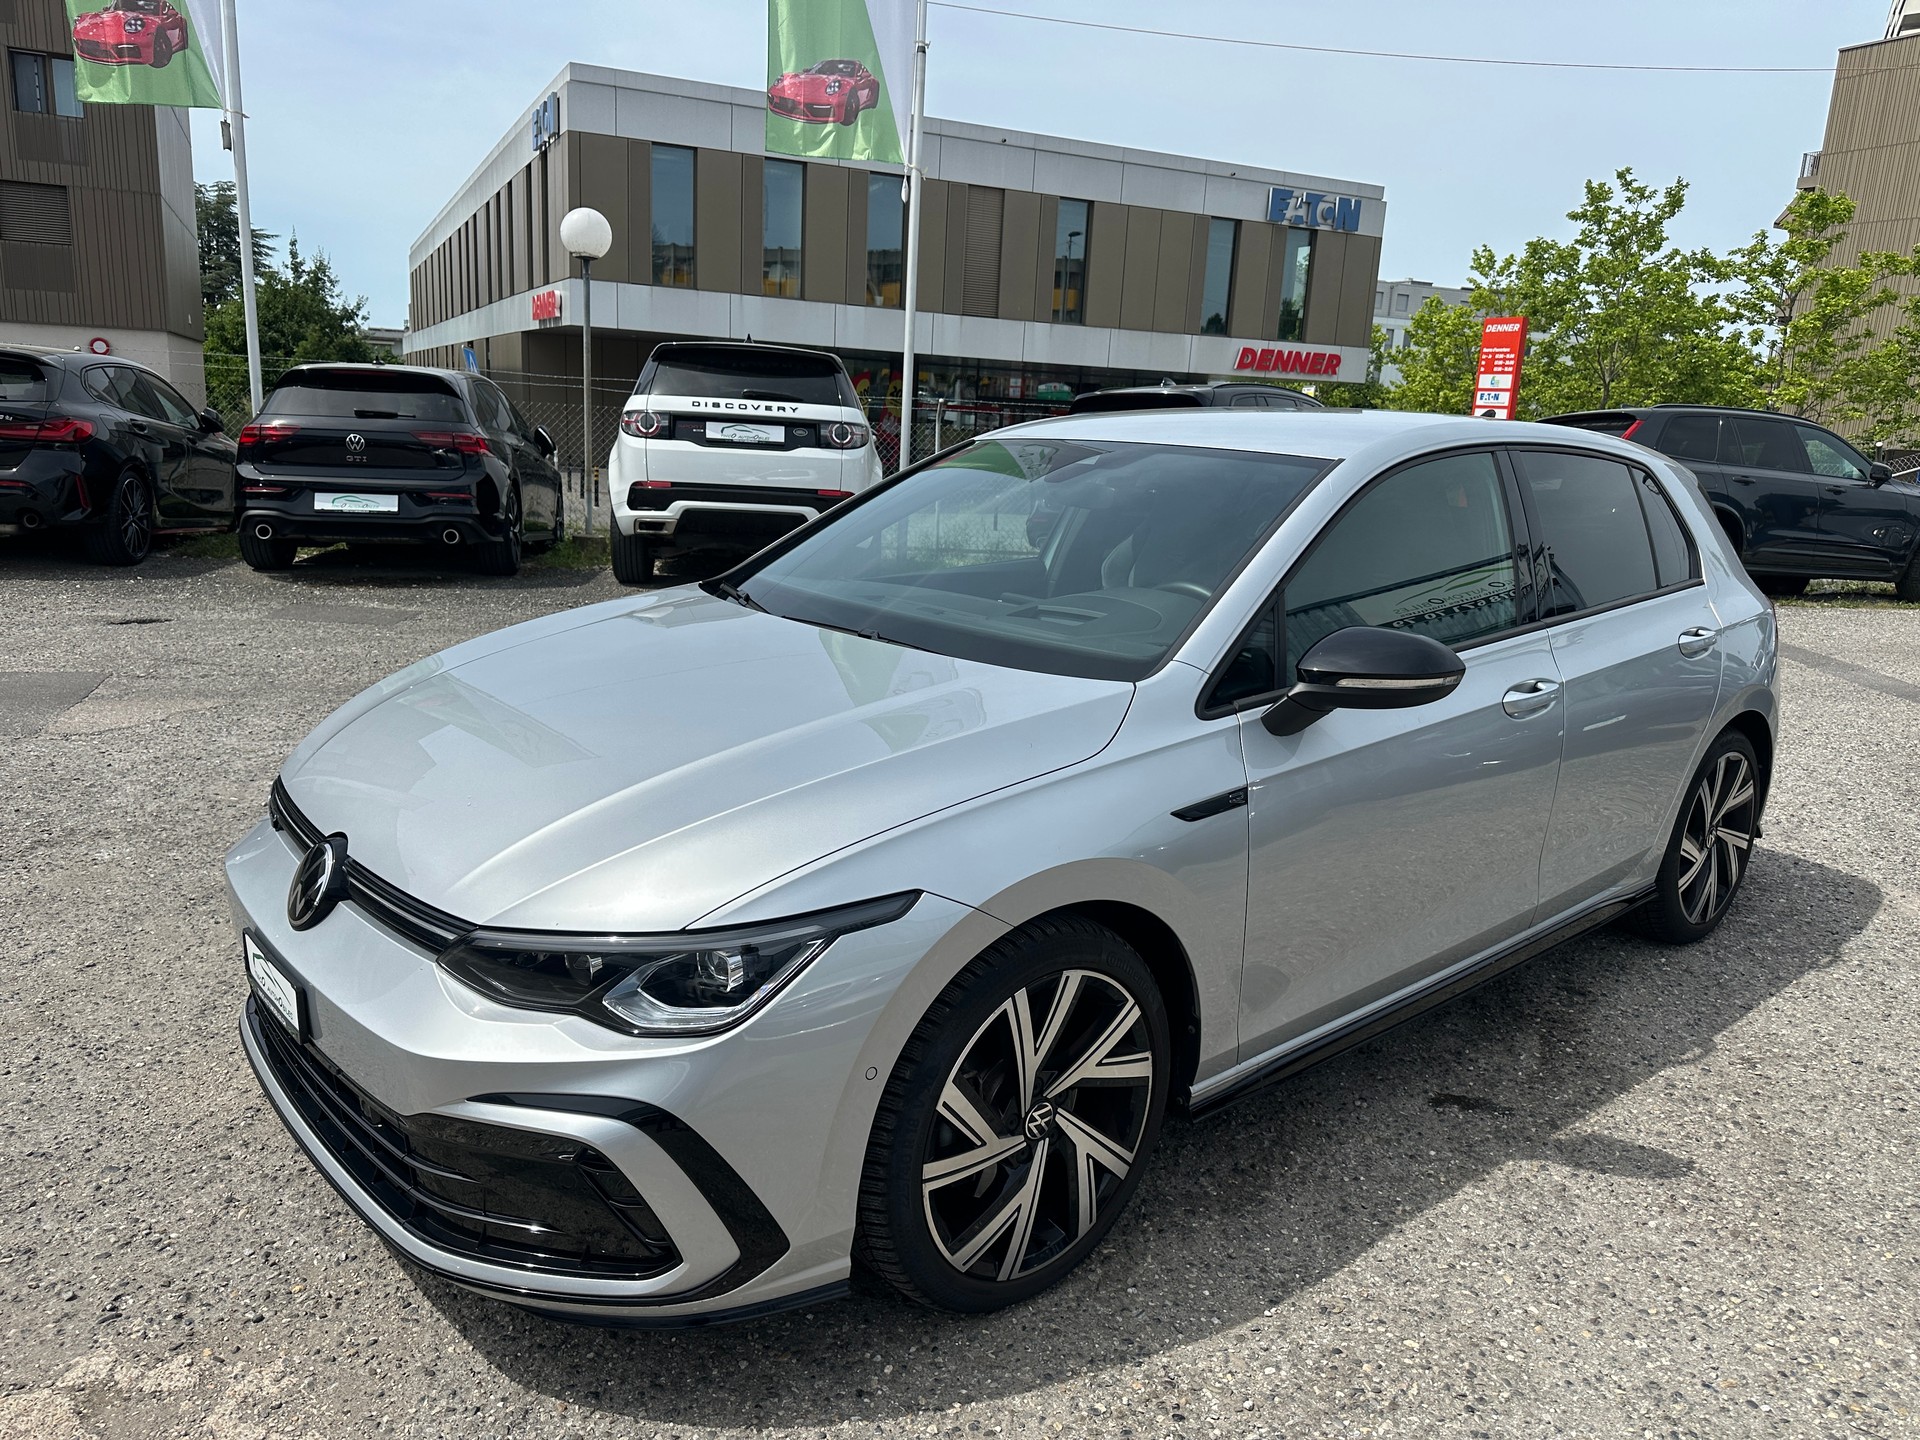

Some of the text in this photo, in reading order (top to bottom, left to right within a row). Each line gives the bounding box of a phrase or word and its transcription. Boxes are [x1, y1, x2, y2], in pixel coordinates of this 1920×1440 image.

[1266, 187, 1361, 232] EATON
[532, 290, 560, 320] DENNER
[1485, 323, 1520, 333] DENNER
[1234, 347, 1341, 376] DENNER
[692, 401, 798, 413] DISCOVERY
